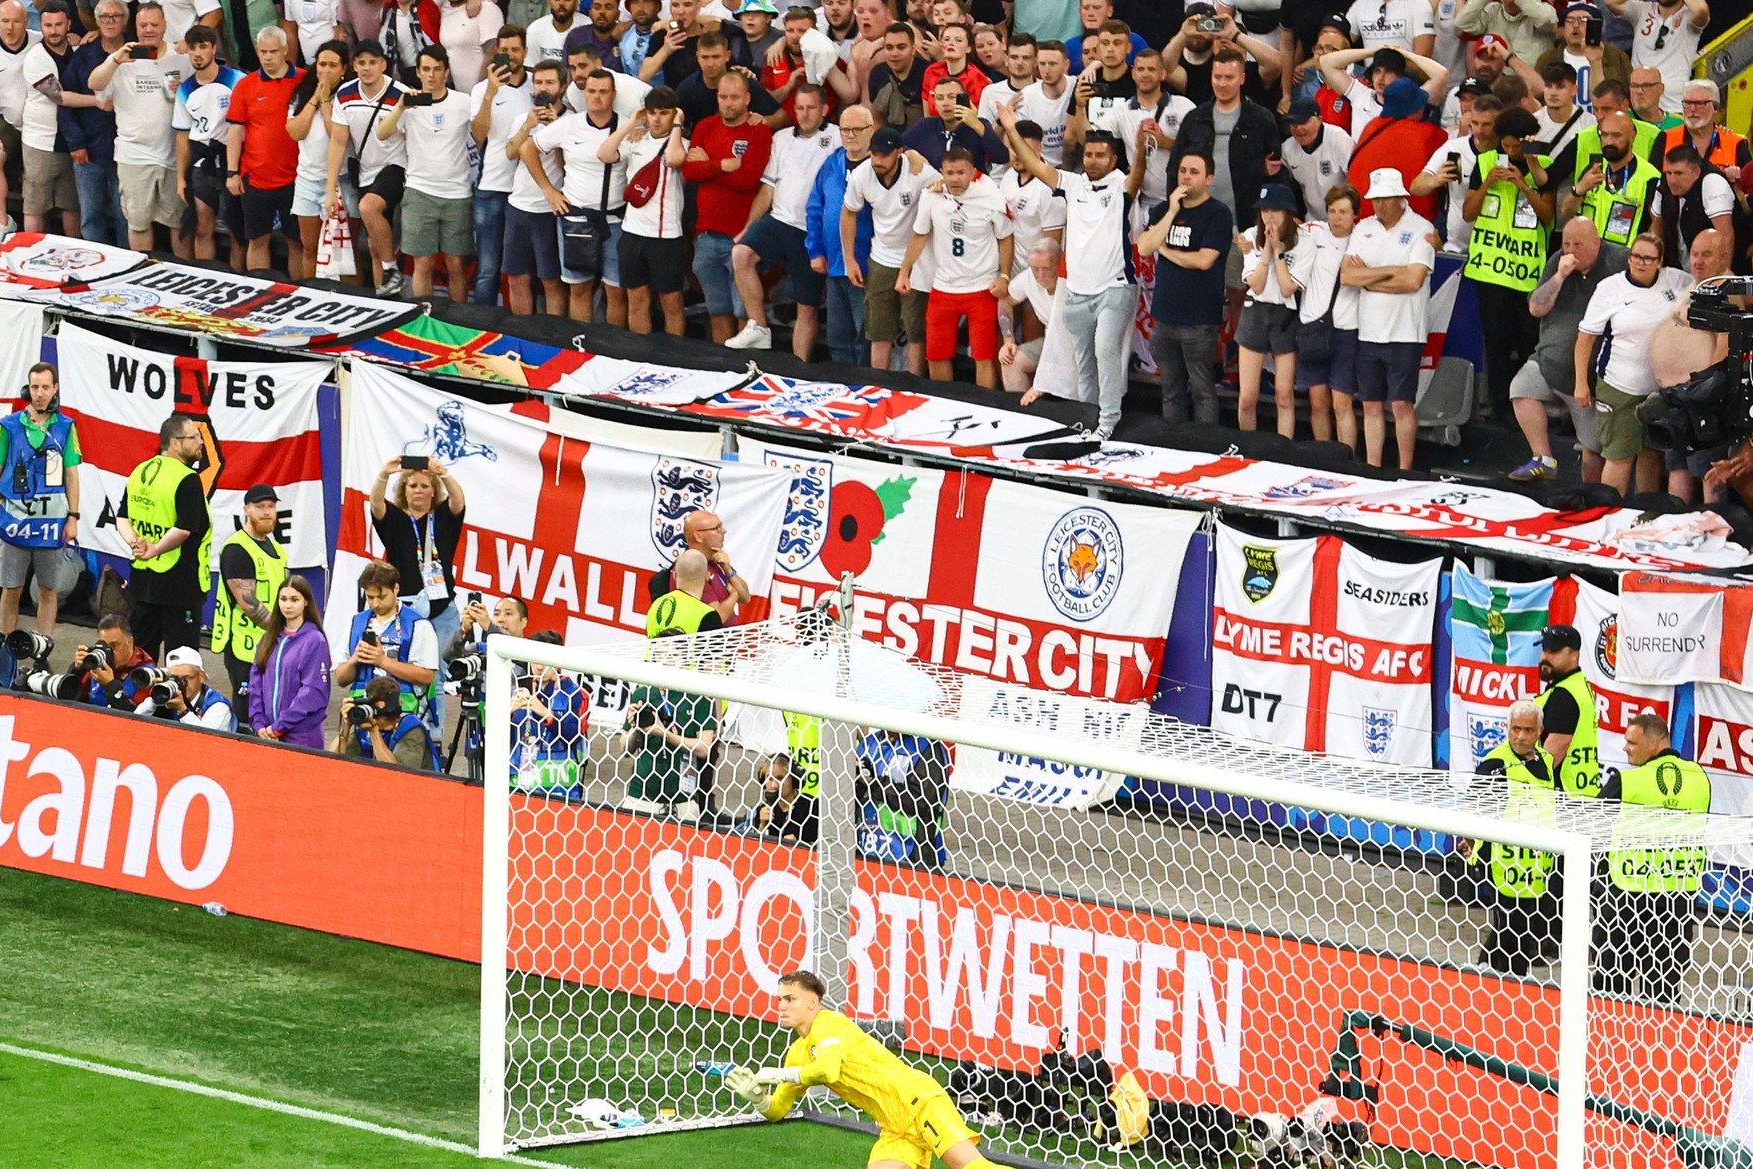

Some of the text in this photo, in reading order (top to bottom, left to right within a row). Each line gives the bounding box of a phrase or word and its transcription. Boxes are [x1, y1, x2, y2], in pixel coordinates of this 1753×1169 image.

[951, 238, 965, 257] 8
[126, 269, 306, 317] LEICESTER
[295, 299, 396, 329] CITY
[106, 353, 276, 411] WOLVES
[25, 496, 51, 516] CT
[5, 523, 60, 541] 04-11
[1050, 514, 1118, 566] LEICESTER CITY
[1245, 547, 1275, 561] LYME
[1247, 558, 1275, 572] REGIS
[1047, 562, 1116, 614] FOOTBALL CLUB
[1343, 580, 1429, 607] SEASIDERS
[1657, 612, 1679, 628] NO
[1038, 630, 1156, 695] CITY
[1214, 614, 1423, 677] LYME REGIS AFC
[1221, 682, 1283, 724] DT7
[647, 849, 1244, 1087] SPORTWETTEN
[922, 1119, 939, 1138] 1
